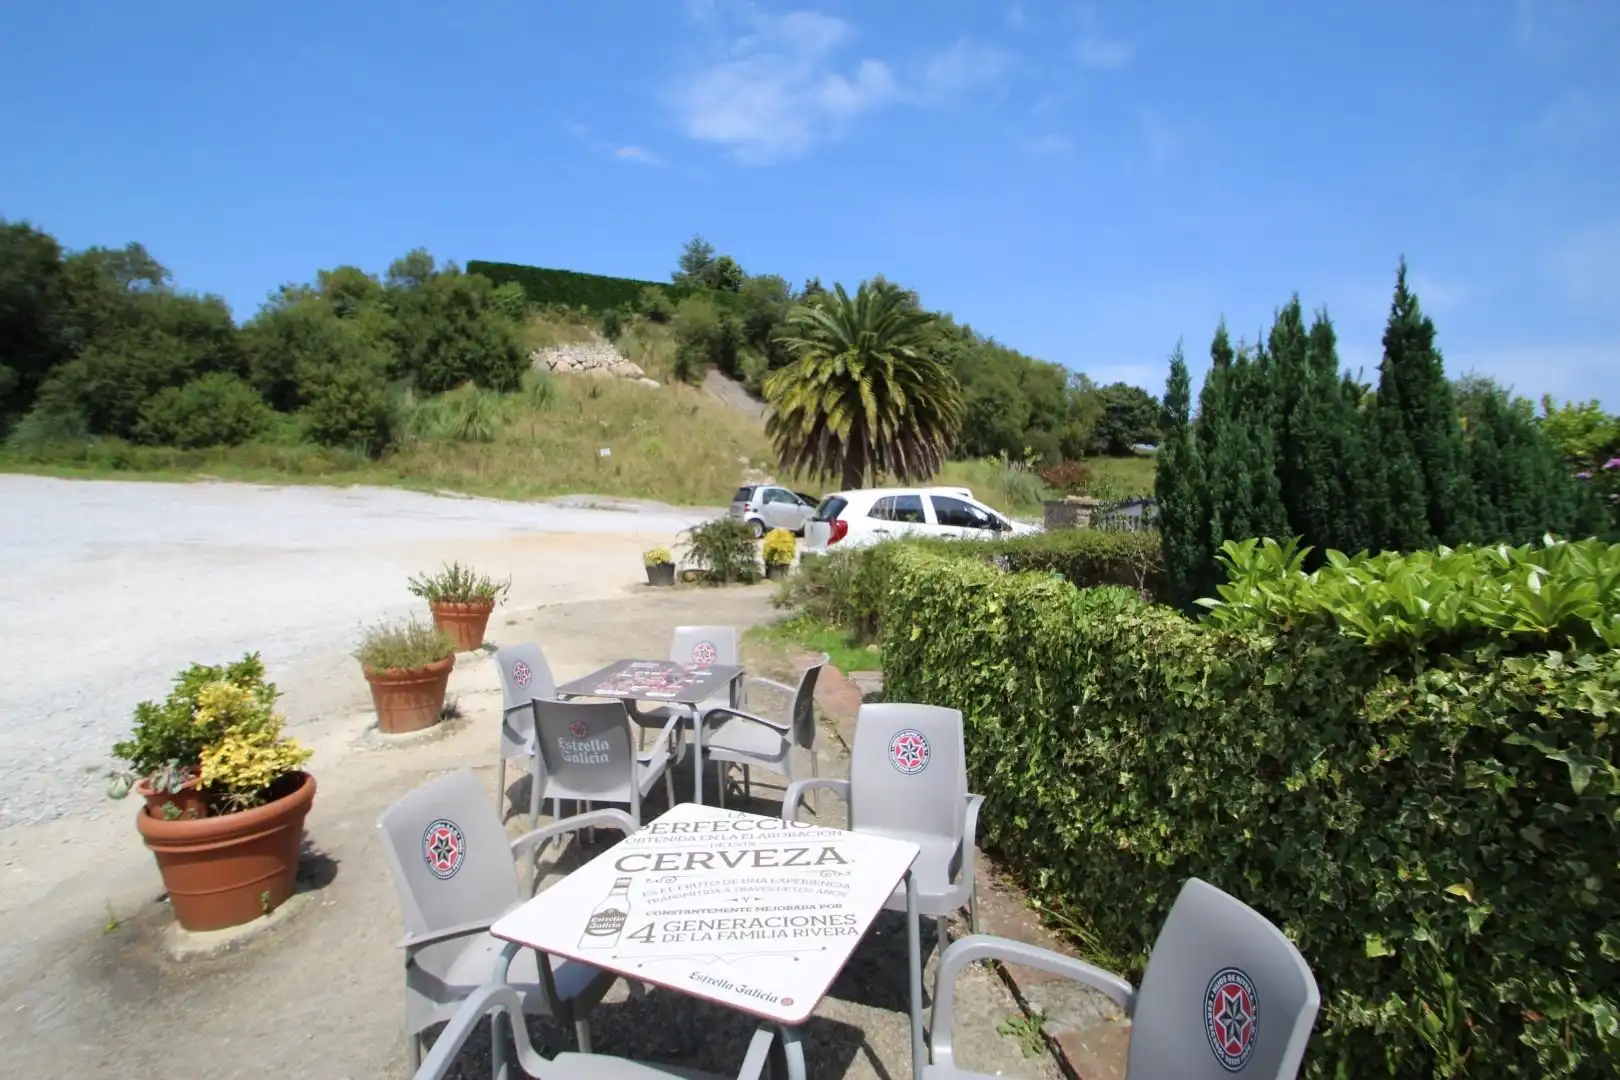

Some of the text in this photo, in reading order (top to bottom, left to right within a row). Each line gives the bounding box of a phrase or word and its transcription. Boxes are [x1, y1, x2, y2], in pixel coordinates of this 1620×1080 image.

[558, 736, 610, 752] Estrella
[560, 750, 609, 764] Galicia
[646, 902, 843, 917] CONSTANTEMENTE MEJORADA POR
[663, 913, 858, 933] GENERACIONES
[626, 921, 657, 944] 4
[662, 926, 859, 944] DE LA FAMILIA RIVERA
[688, 971, 779, 1004] Estrella Galicia
